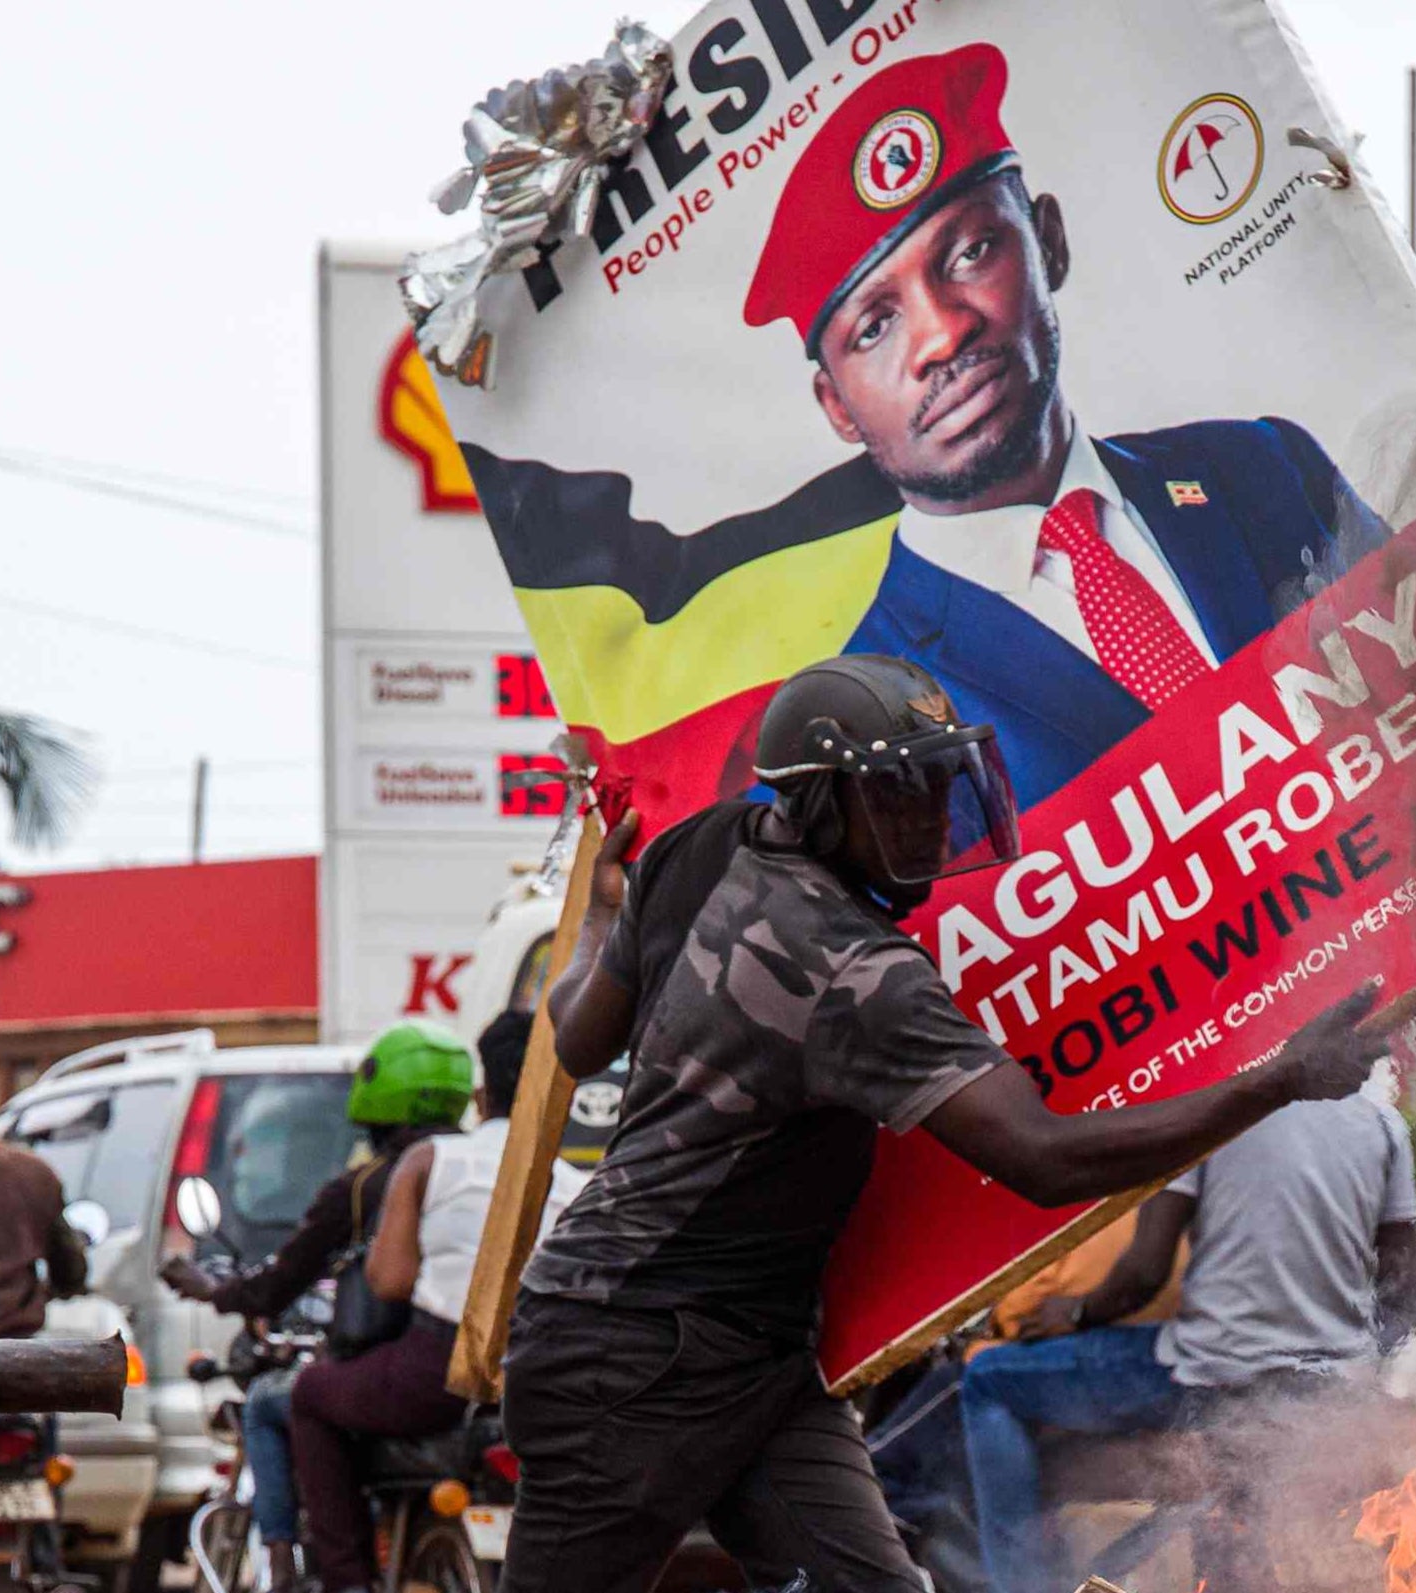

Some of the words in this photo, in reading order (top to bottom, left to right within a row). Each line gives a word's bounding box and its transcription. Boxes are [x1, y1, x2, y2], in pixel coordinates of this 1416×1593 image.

[601, 187, 715, 295] People
[716, 90, 822, 190] Power
[851, 0, 917, 66] Our
[1184, 217, 1263, 286] NATIONAL
[1262, 170, 1305, 219] UNITY
[1218, 212, 1297, 285] PLATFORM
[1186, 813, 1394, 980] WINE
[1128, 1055, 1165, 1093] OF
[1164, 1018, 1224, 1066] THE
[1223, 932, 1349, 1028] COMMON
